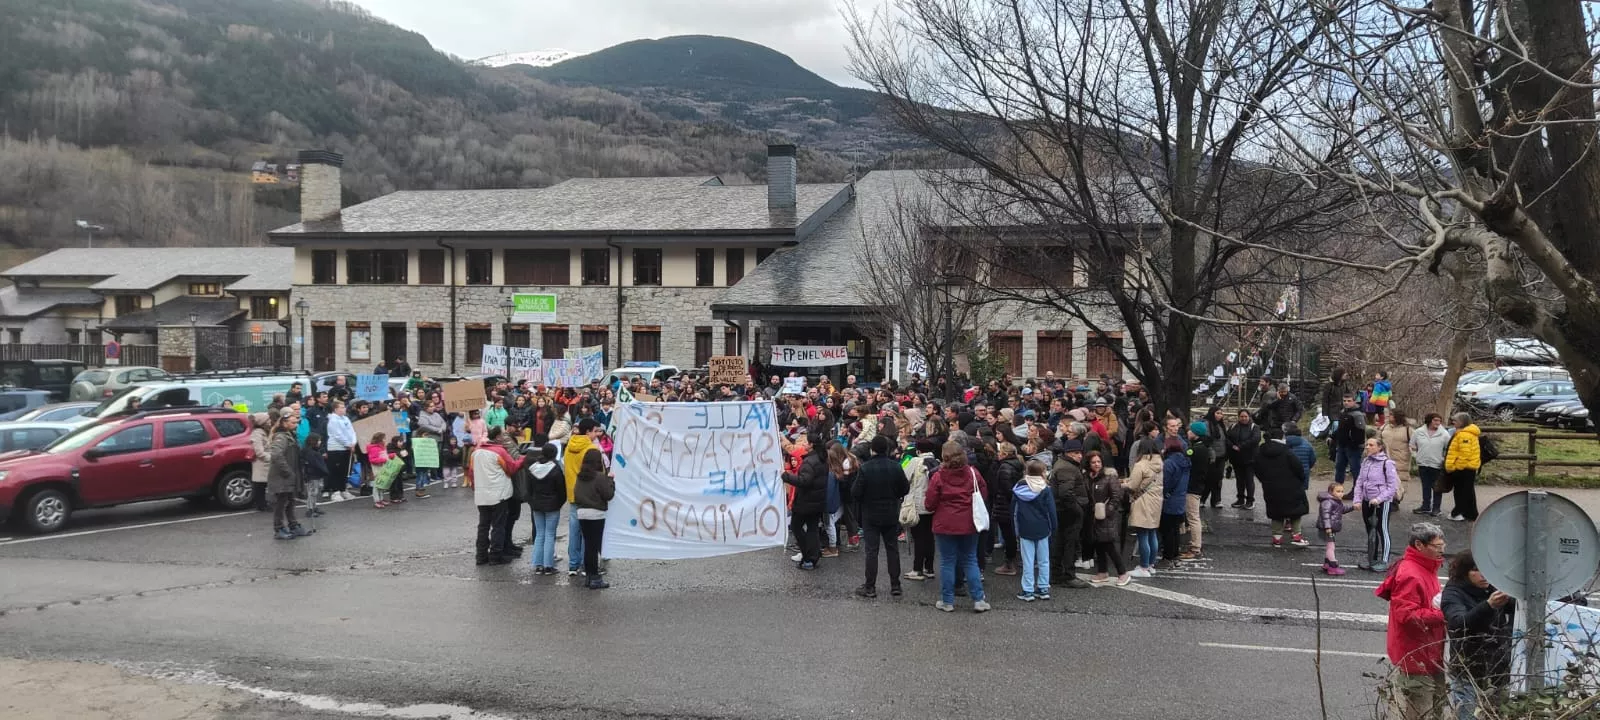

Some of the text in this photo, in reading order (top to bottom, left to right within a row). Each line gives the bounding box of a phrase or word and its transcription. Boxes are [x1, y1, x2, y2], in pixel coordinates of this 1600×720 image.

[513, 348, 538, 358] VALLE
[783, 347, 796, 363] FP
[797, 349, 808, 361] EN
[809, 349, 820, 360] EL
[820, 346, 846, 359] VALLE
[484, 354, 541, 368] UNA CMUNIDAD
[711, 358, 744, 366] INSTITUTO
